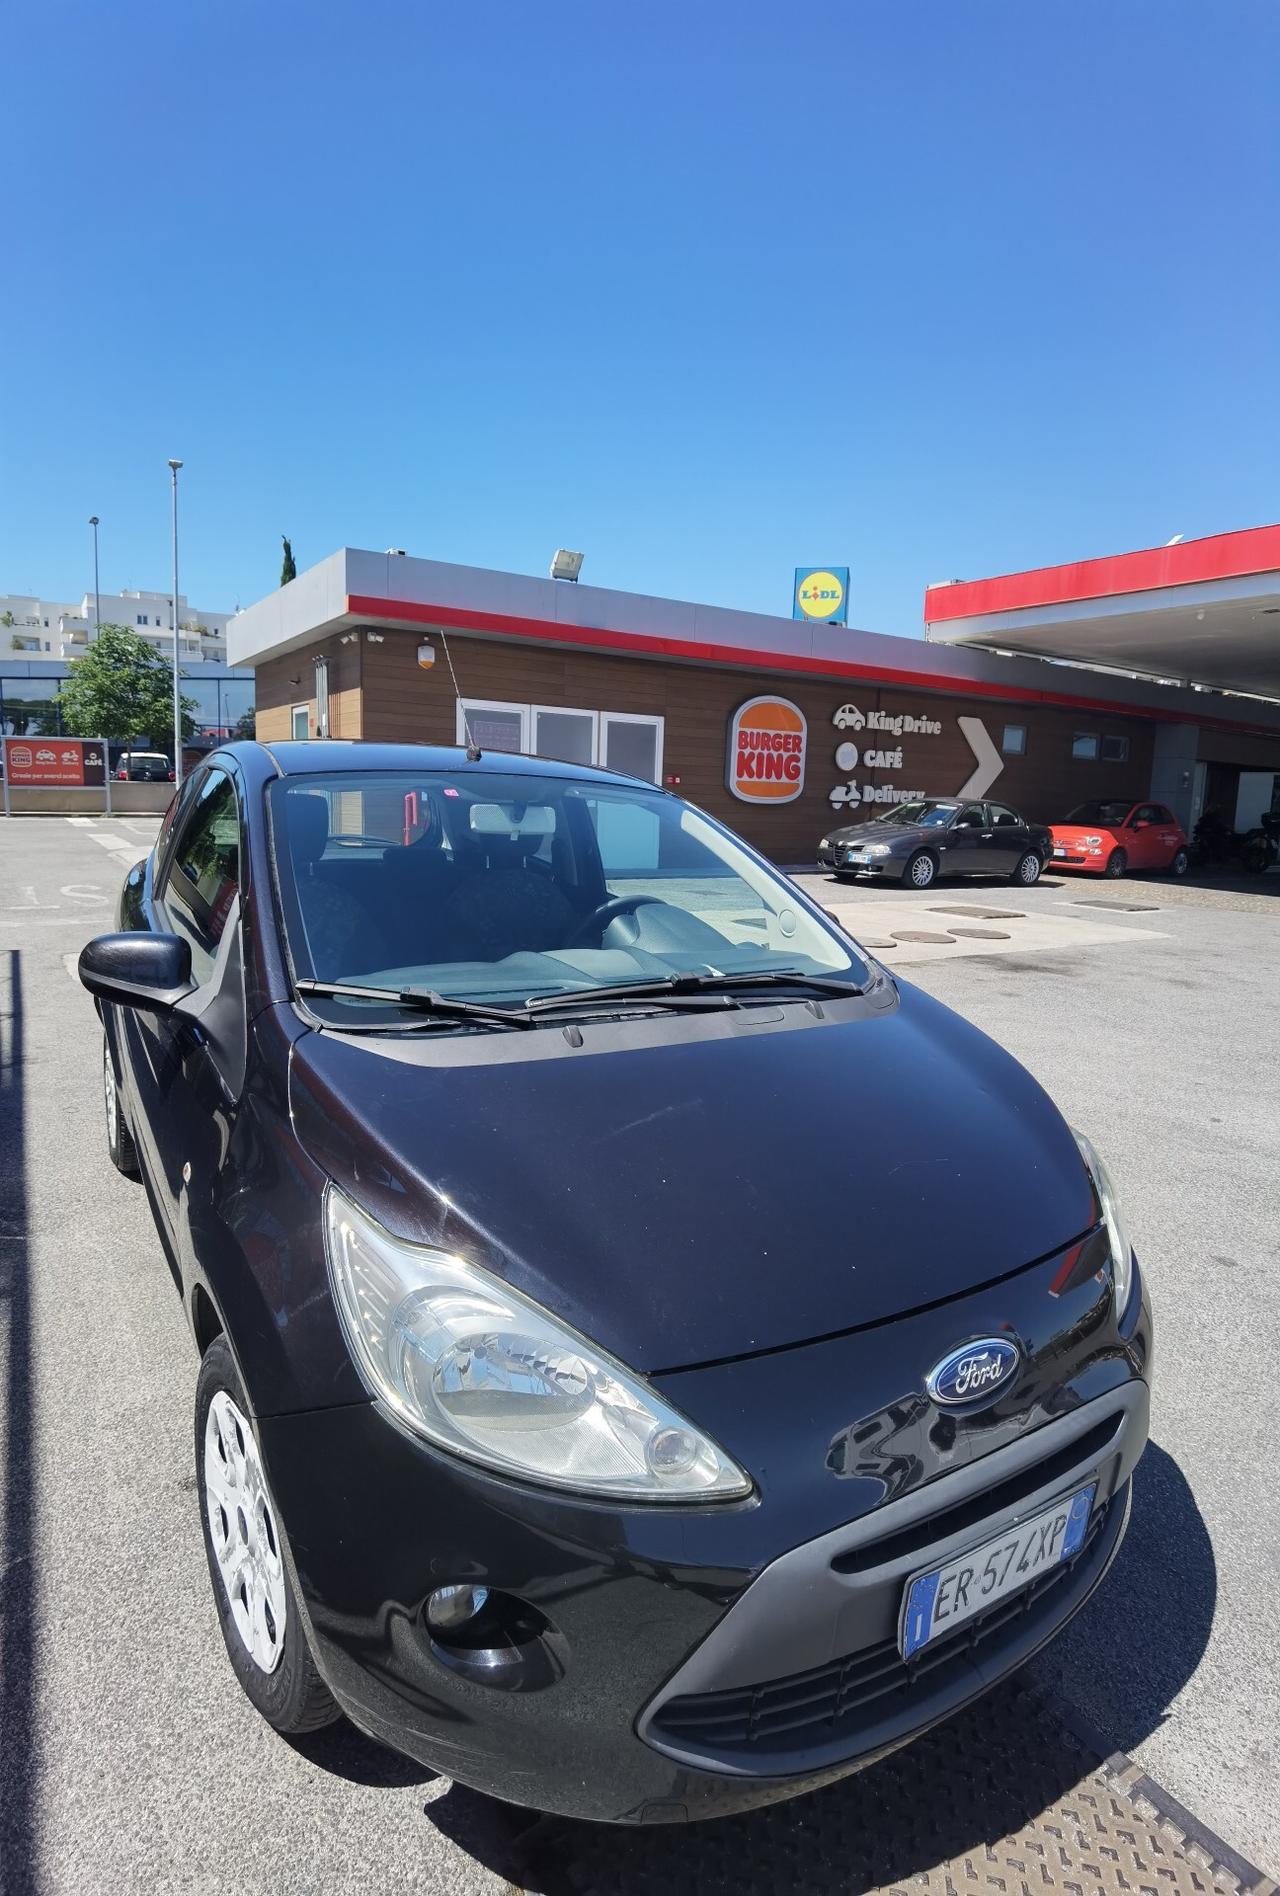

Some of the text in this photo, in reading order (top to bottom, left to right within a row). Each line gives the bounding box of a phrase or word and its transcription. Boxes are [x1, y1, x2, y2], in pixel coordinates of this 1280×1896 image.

[738, 730, 803, 753] BURGER
[736, 751, 801, 781] KING
[863, 746, 903, 769] CAFÉ
[955, 1351, 1003, 1394] Ford
